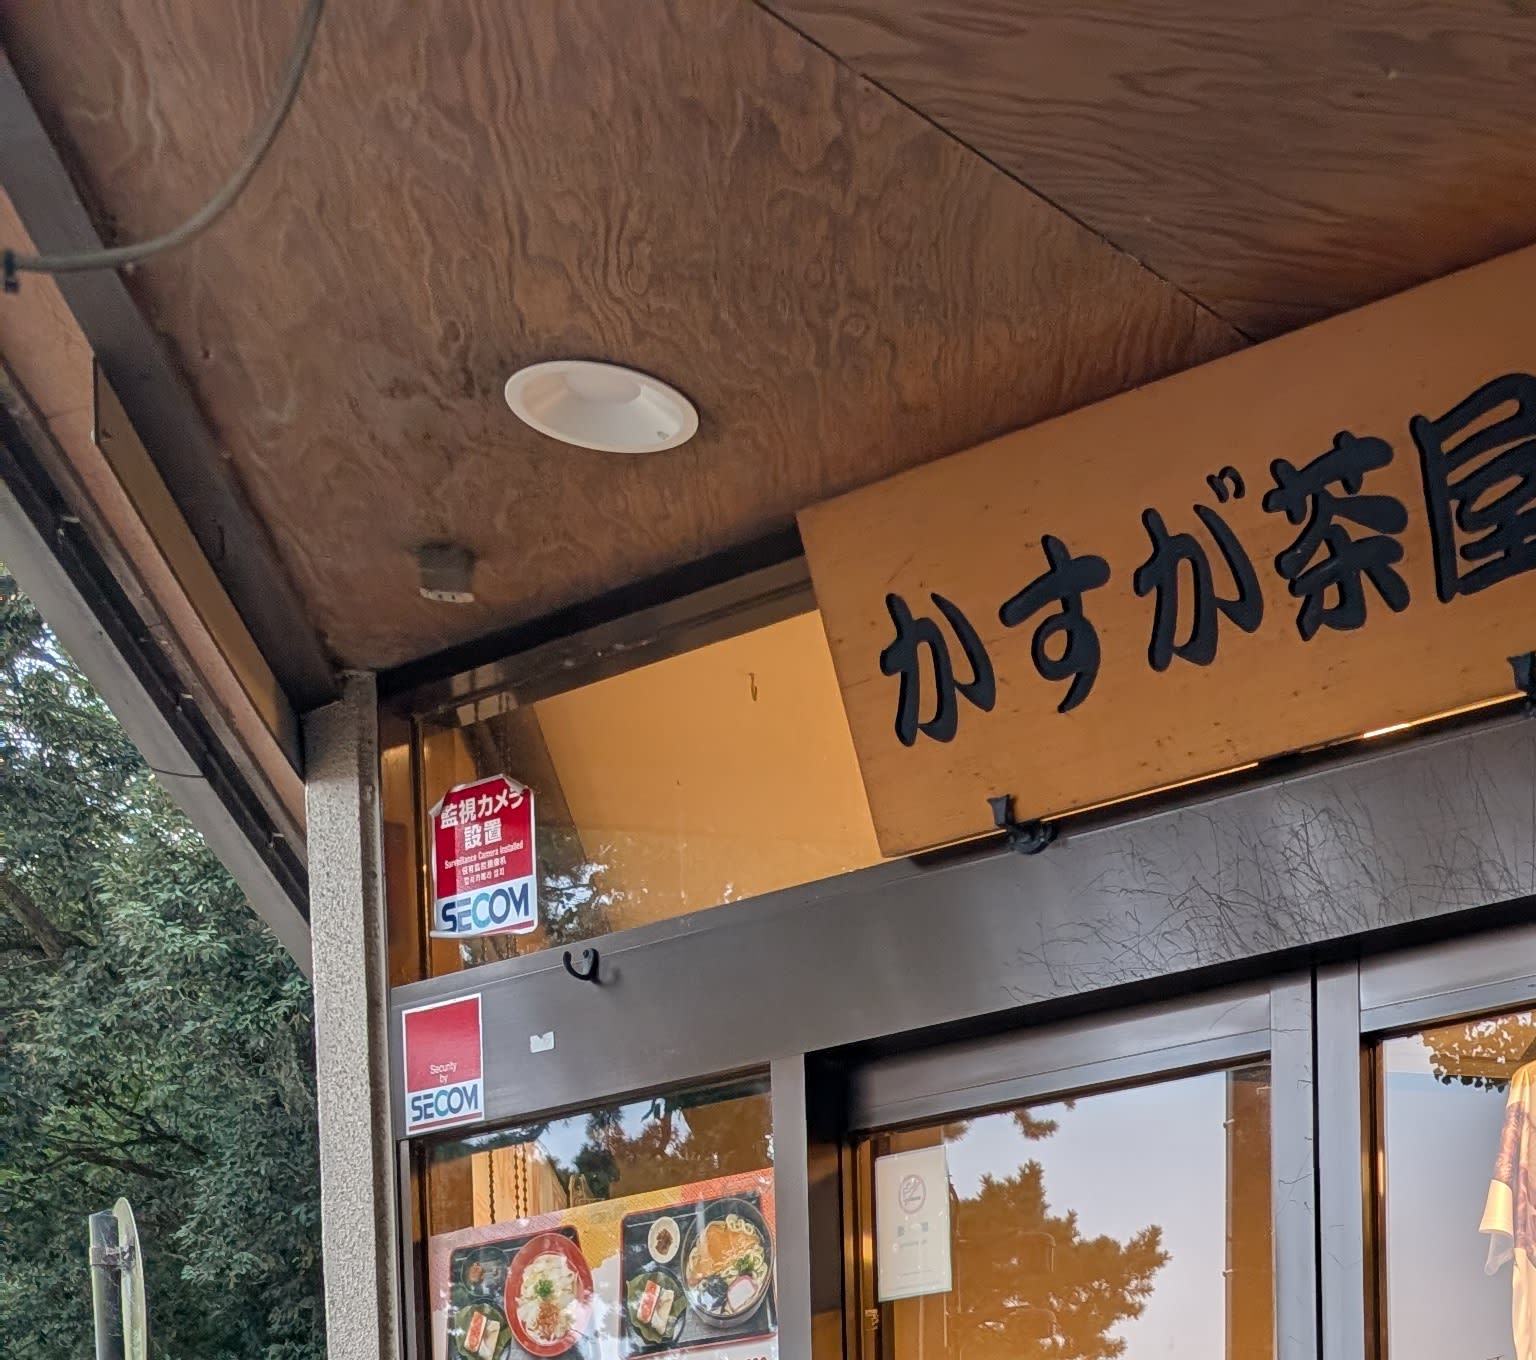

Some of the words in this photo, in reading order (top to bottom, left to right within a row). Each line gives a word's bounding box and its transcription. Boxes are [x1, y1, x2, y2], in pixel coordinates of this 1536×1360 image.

[441, 788, 523, 829] 監視カメラ
[464, 818, 502, 850] 設置
[441, 882, 530, 933] SECOM
[430, 1062, 457, 1074] Security
[439, 1073, 448, 1083] by
[411, 1083, 478, 1122] SECOM
